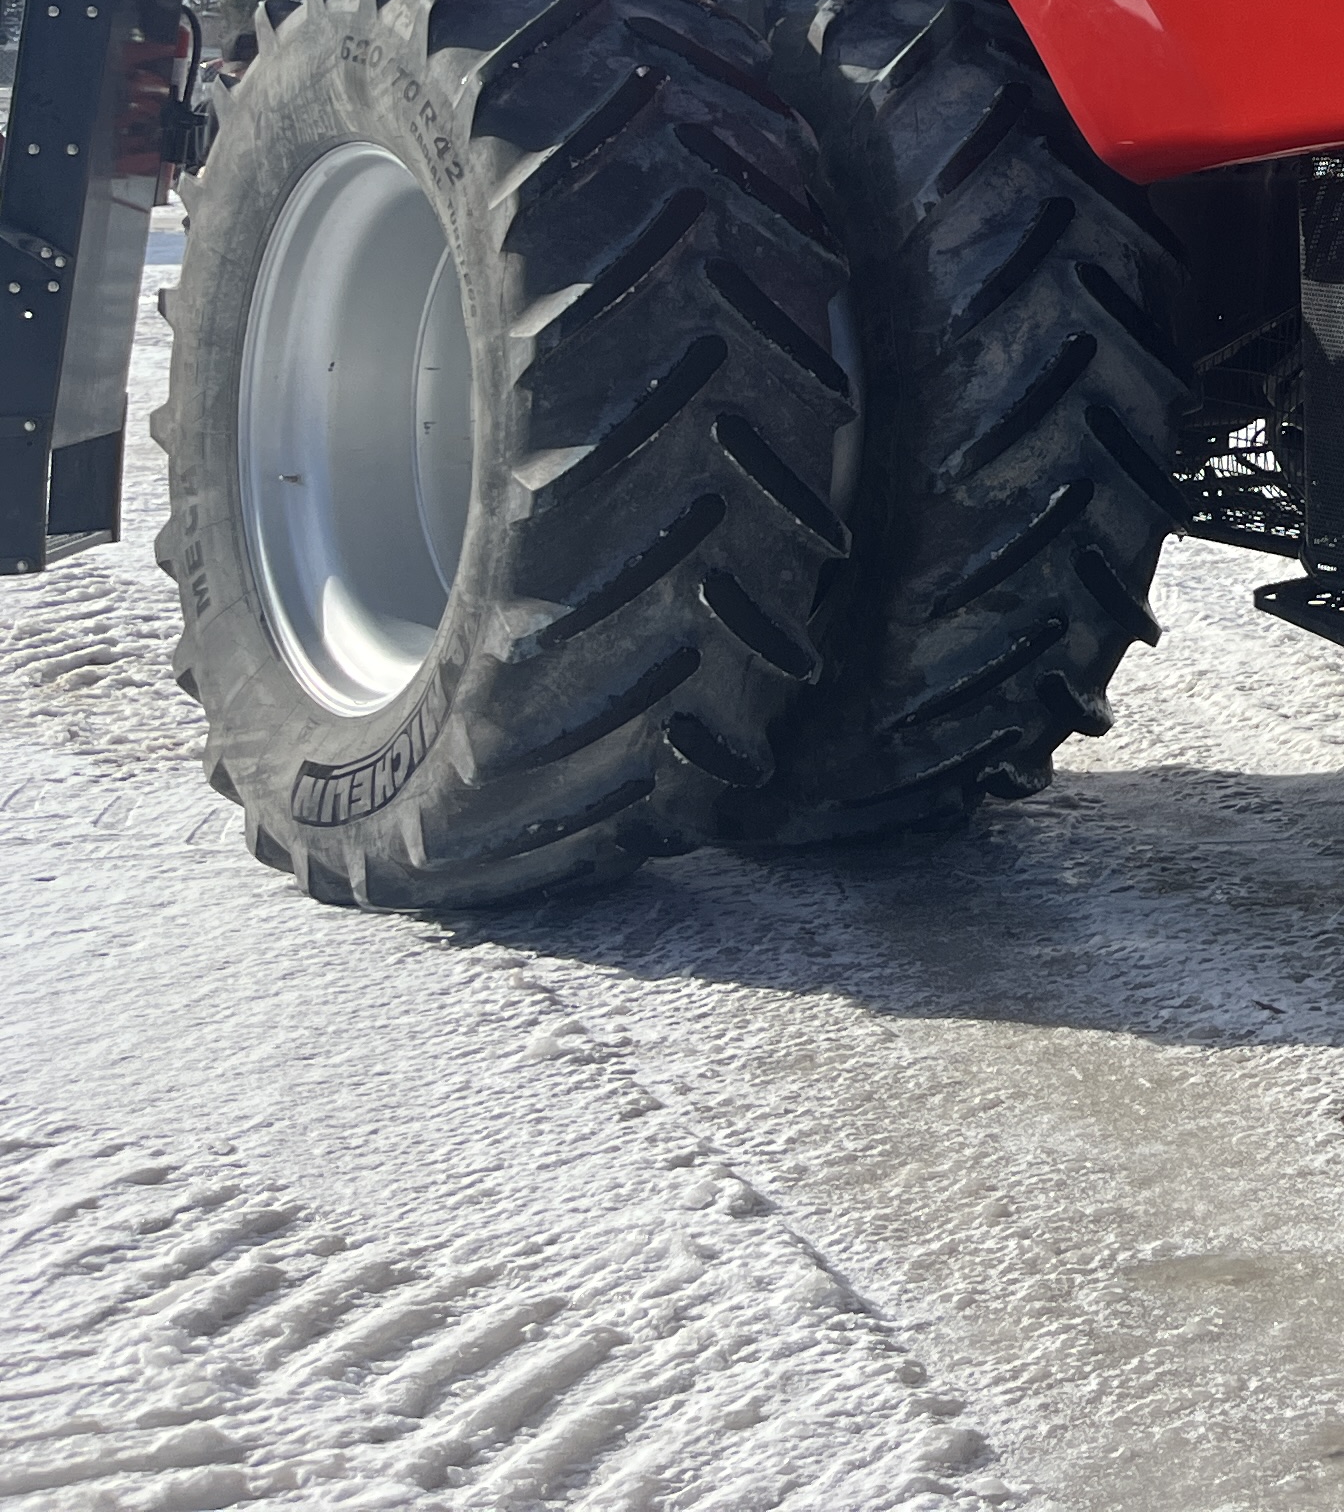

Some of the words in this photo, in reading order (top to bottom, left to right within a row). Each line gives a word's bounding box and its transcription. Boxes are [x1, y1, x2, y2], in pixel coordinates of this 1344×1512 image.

[419, 99, 438, 133] R
[433, 136, 465, 187] 42
[291, 668, 450, 824] MICHELIN
